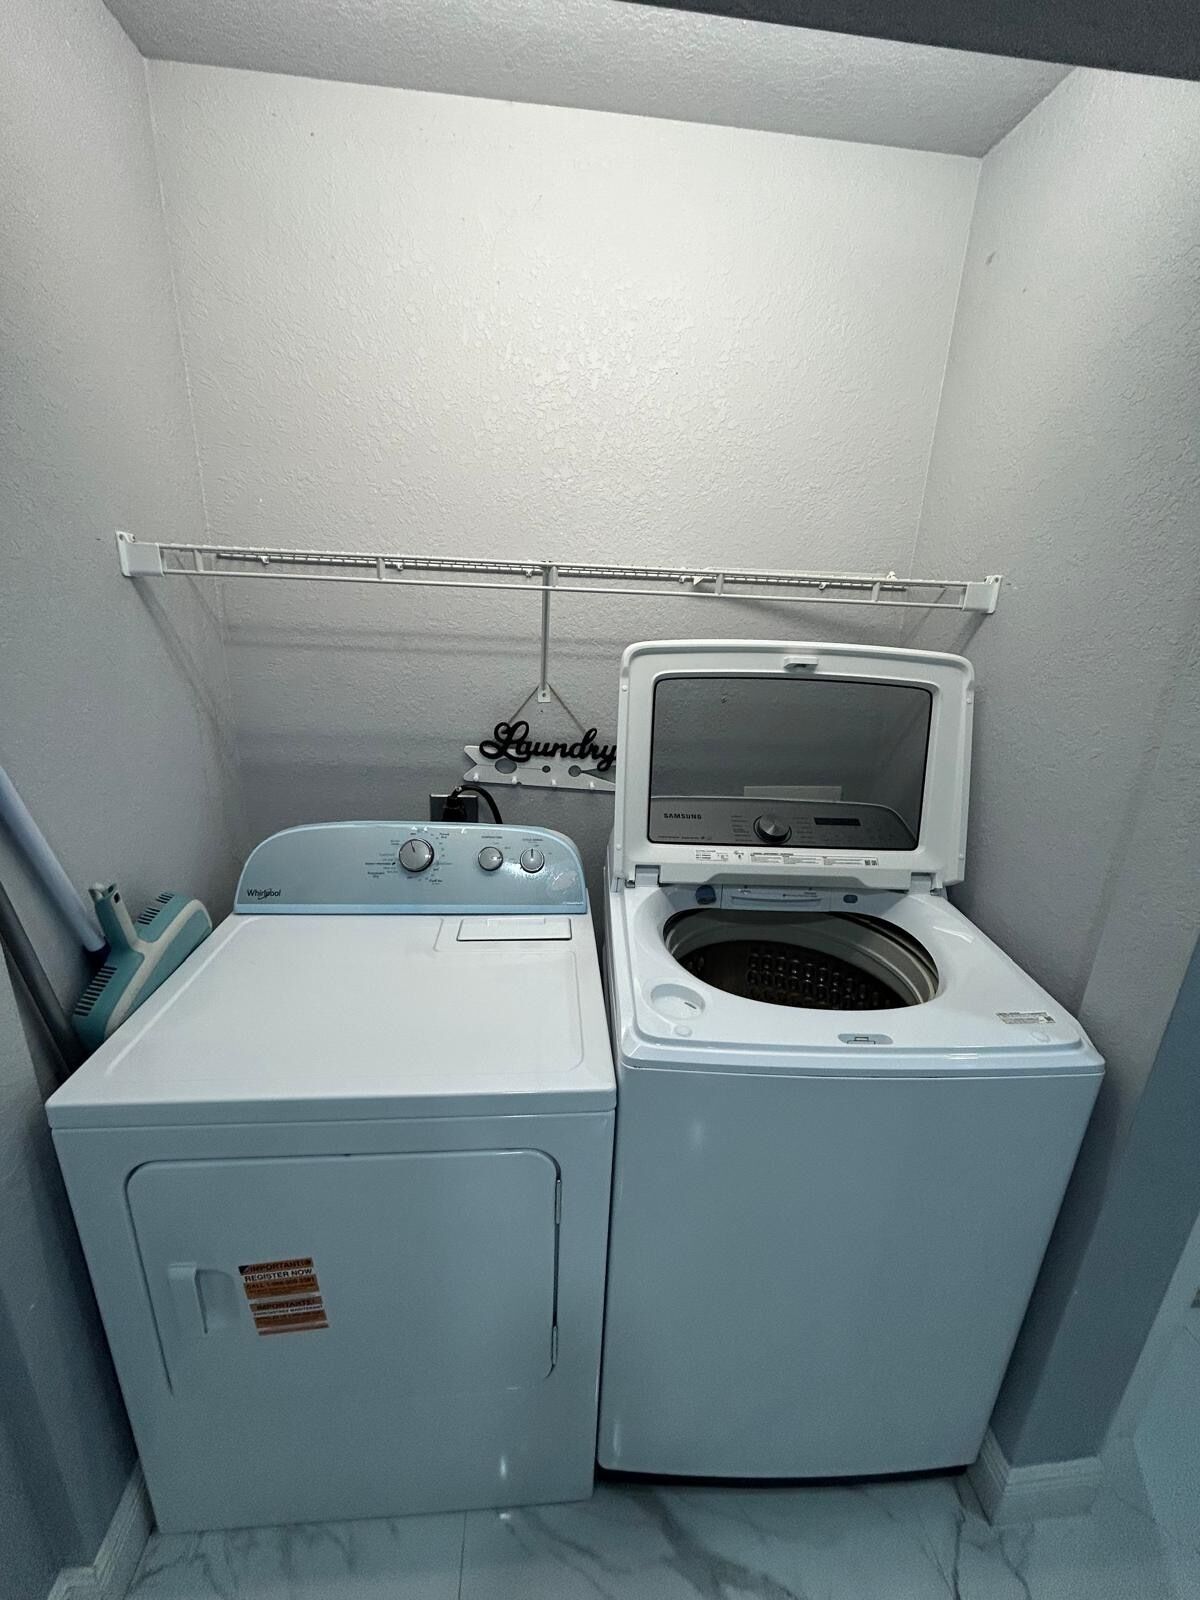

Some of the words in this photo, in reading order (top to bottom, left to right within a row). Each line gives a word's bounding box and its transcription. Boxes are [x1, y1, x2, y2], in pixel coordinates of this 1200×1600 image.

[479, 721, 617, 771] Laundry
[663, 812, 702, 820] SAMSUNG
[247, 888, 281, 900] Whirlpool
[244, 1271, 289, 1282] REGISTER
[291, 1268, 312, 1276] NOW
